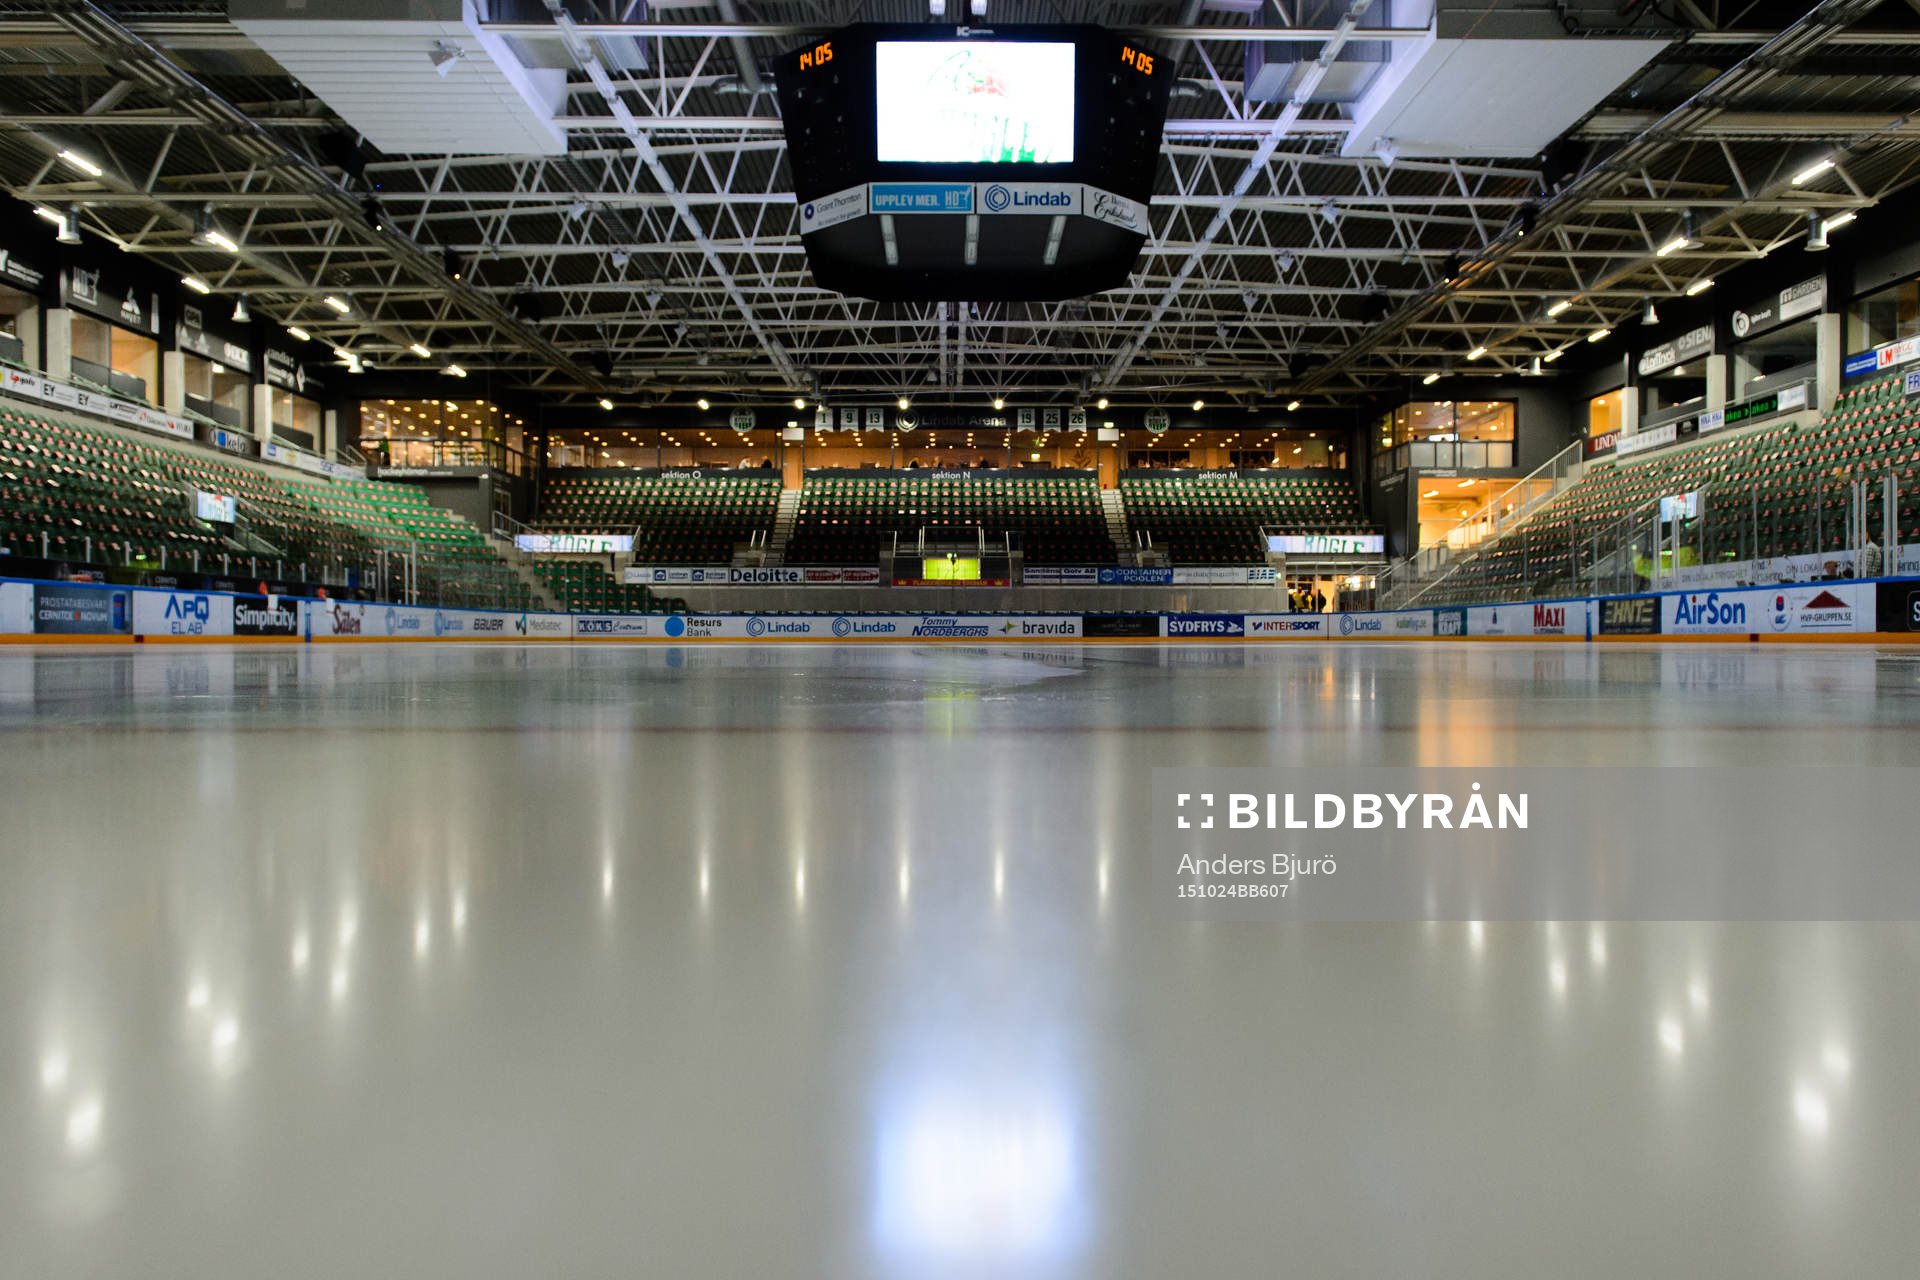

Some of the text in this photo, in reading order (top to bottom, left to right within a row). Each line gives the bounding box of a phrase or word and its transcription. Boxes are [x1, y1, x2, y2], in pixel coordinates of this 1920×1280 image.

[815, 42, 833, 65] 05
[1136, 52, 1154, 75] 05
[875, 194, 914, 207] UPPLEV
[1013, 191, 1072, 206] Lindab
[1880, 349, 1893, 367] LM
[44, 383, 55, 397] EY
[78, 393, 89, 407] EY
[822, 413, 826, 423] 1
[846, 412, 853, 423] 9
[869, 413, 880, 423] 13
[968, 415, 1007, 426] Arena
[1021, 413, 1031, 424] 19
[1046, 413, 1058, 424] 25
[1071, 413, 1084, 424] 26
[661, 470, 701, 479] sektion O
[932, 471, 971, 480] sektion N
[1198, 471, 1238, 480] sektion M
[730, 569, 802, 582] Deloitte.
[1116, 568, 1171, 576] CONTAINER
[1674, 592, 1746, 625] AirSon
[474, 618, 504, 631] BAUER
[686, 618, 722, 628] Resurs
[767, 621, 811, 634] Lindab
[853, 621, 897, 634] Lindab
[921, 618, 958, 627] Tommy
[1022, 620, 1075, 634] bravida
[1169, 620, 1226, 633] SYDFRYS
[1263, 621, 1321, 631] INTERSPORT
[1354, 616, 1383, 631] Lindab
[686, 627, 712, 637] Bank
[911, 625, 989, 637] NORDBERGHS
